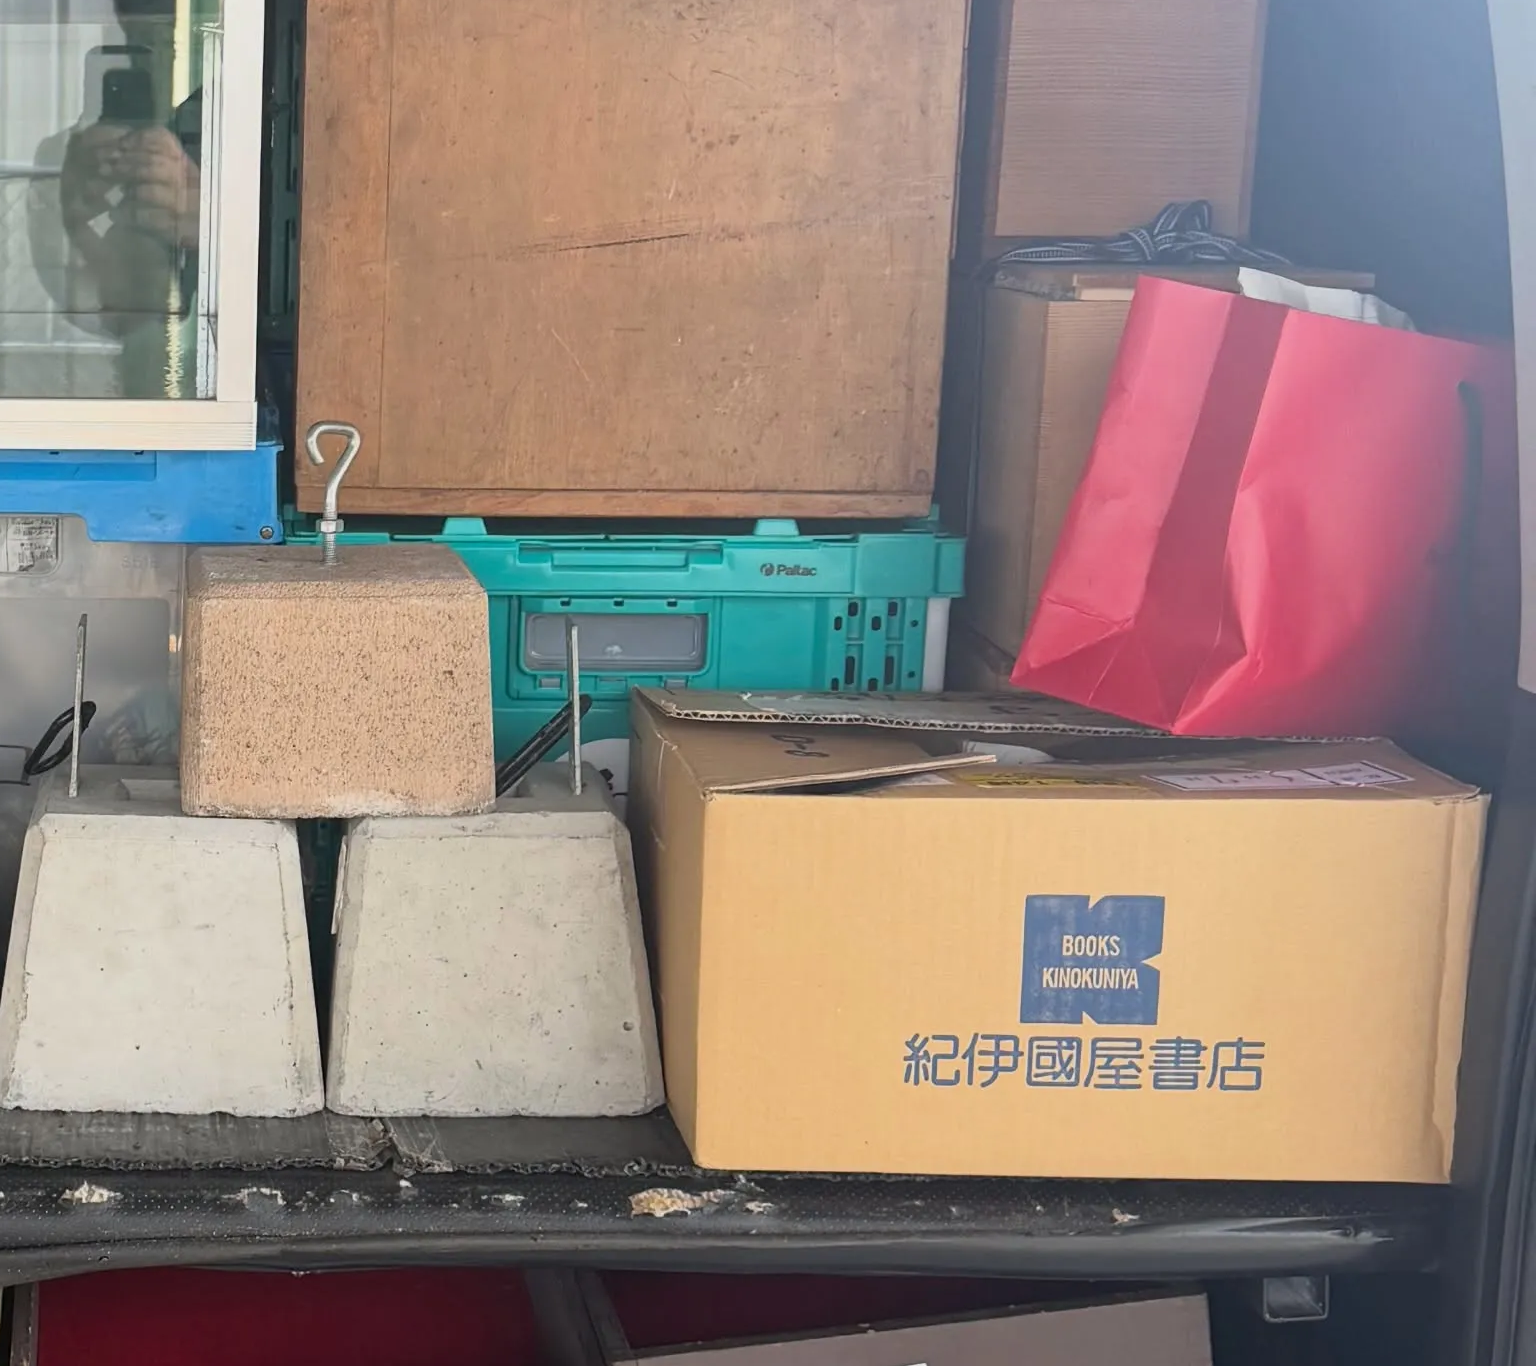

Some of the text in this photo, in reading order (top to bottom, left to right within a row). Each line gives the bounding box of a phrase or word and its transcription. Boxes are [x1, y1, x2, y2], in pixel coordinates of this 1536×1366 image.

[776, 564, 817, 577] Paltac
[1062, 934, 1120, 958] BOOKS
[1042, 967, 1139, 991] KINOKUNIYA
[902, 1033, 1266, 1092] 紀伊國屋書店
